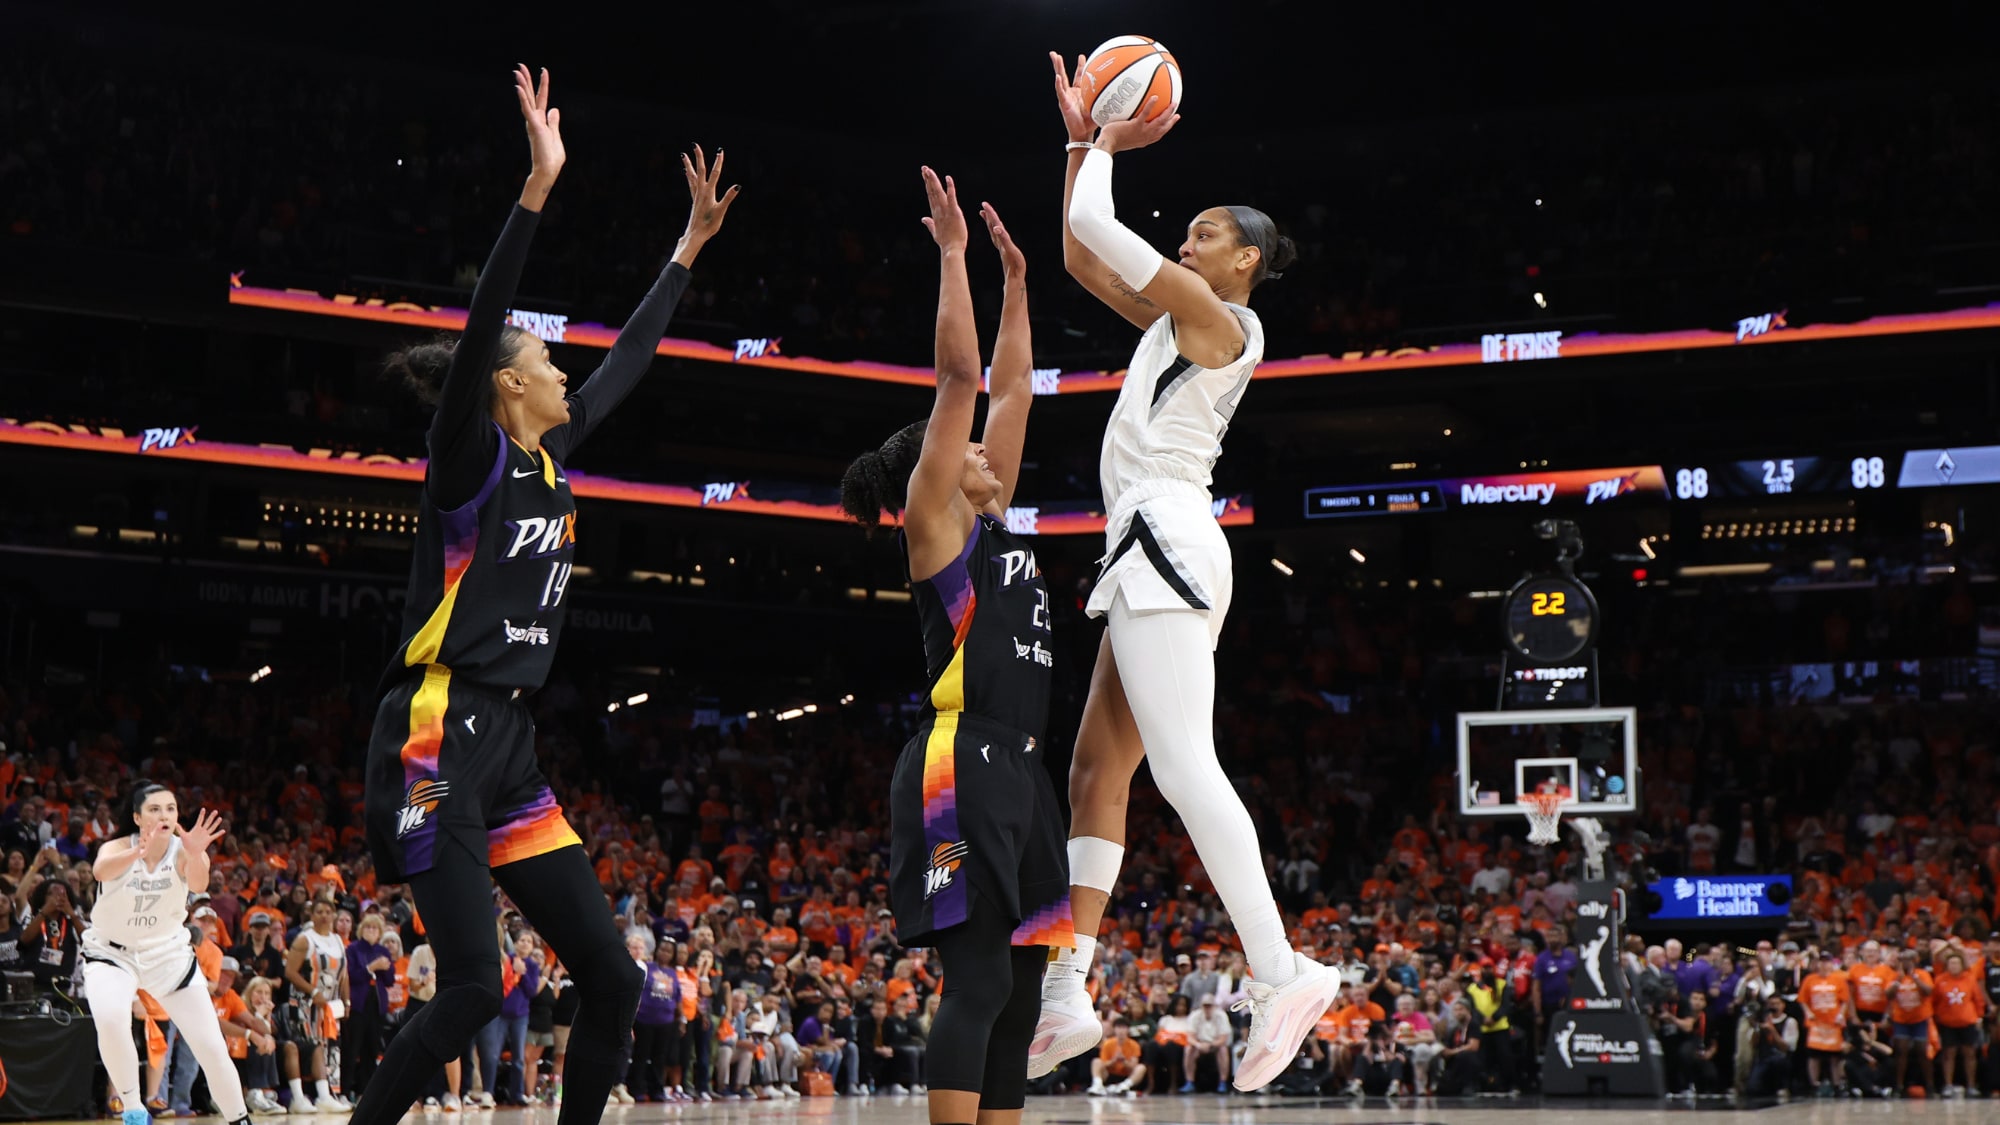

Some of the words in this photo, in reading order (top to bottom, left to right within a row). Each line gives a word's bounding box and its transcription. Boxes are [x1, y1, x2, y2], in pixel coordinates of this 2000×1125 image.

[505, 308, 568, 343] FENSE
[1736, 309, 1788, 341] PHX
[735, 337, 782, 360] PHX
[1481, 330, 1562, 363] DEFENSE
[141, 425, 199, 451] PHX
[1676, 468, 1708, 499] 88
[1762, 459, 1794, 485] 2.5
[1851, 457, 1884, 489] 88
[703, 480, 750, 504] PHX
[1461, 482, 1556, 505] Mercury
[1586, 471, 1640, 505] PHX
[504, 510, 577, 560] PHX
[1000, 550, 1041, 587] PH
[541, 561, 573, 608] 14
[565, 608, 655, 634] EQUILA
[1533, 667, 1588, 680] TISSOT
[126, 877, 173, 892] ACES
[1697, 880, 1765, 897] Banner
[133, 894, 161, 913] 17
[1578, 901, 1608, 919] ally
[1697, 898, 1759, 916] Health
[1573, 1040, 1640, 1053] FINALS
